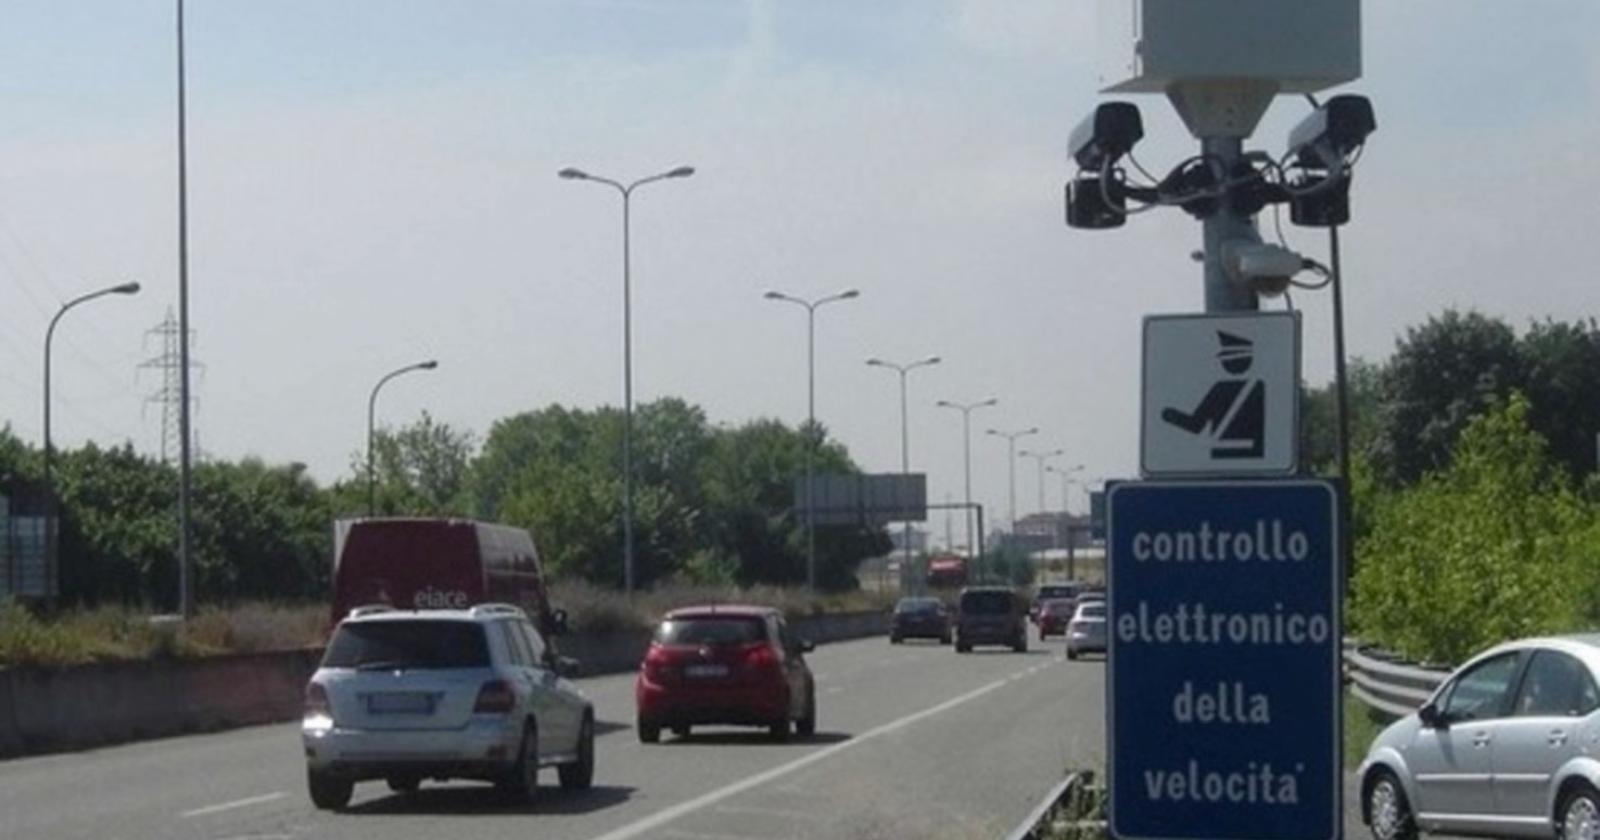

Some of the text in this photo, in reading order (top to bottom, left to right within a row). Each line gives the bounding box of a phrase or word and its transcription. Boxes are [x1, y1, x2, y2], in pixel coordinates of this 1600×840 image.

[1134, 521, 1308, 561] controllo
[1118, 603, 1328, 643] elettronico
[1174, 682, 1270, 724] della
